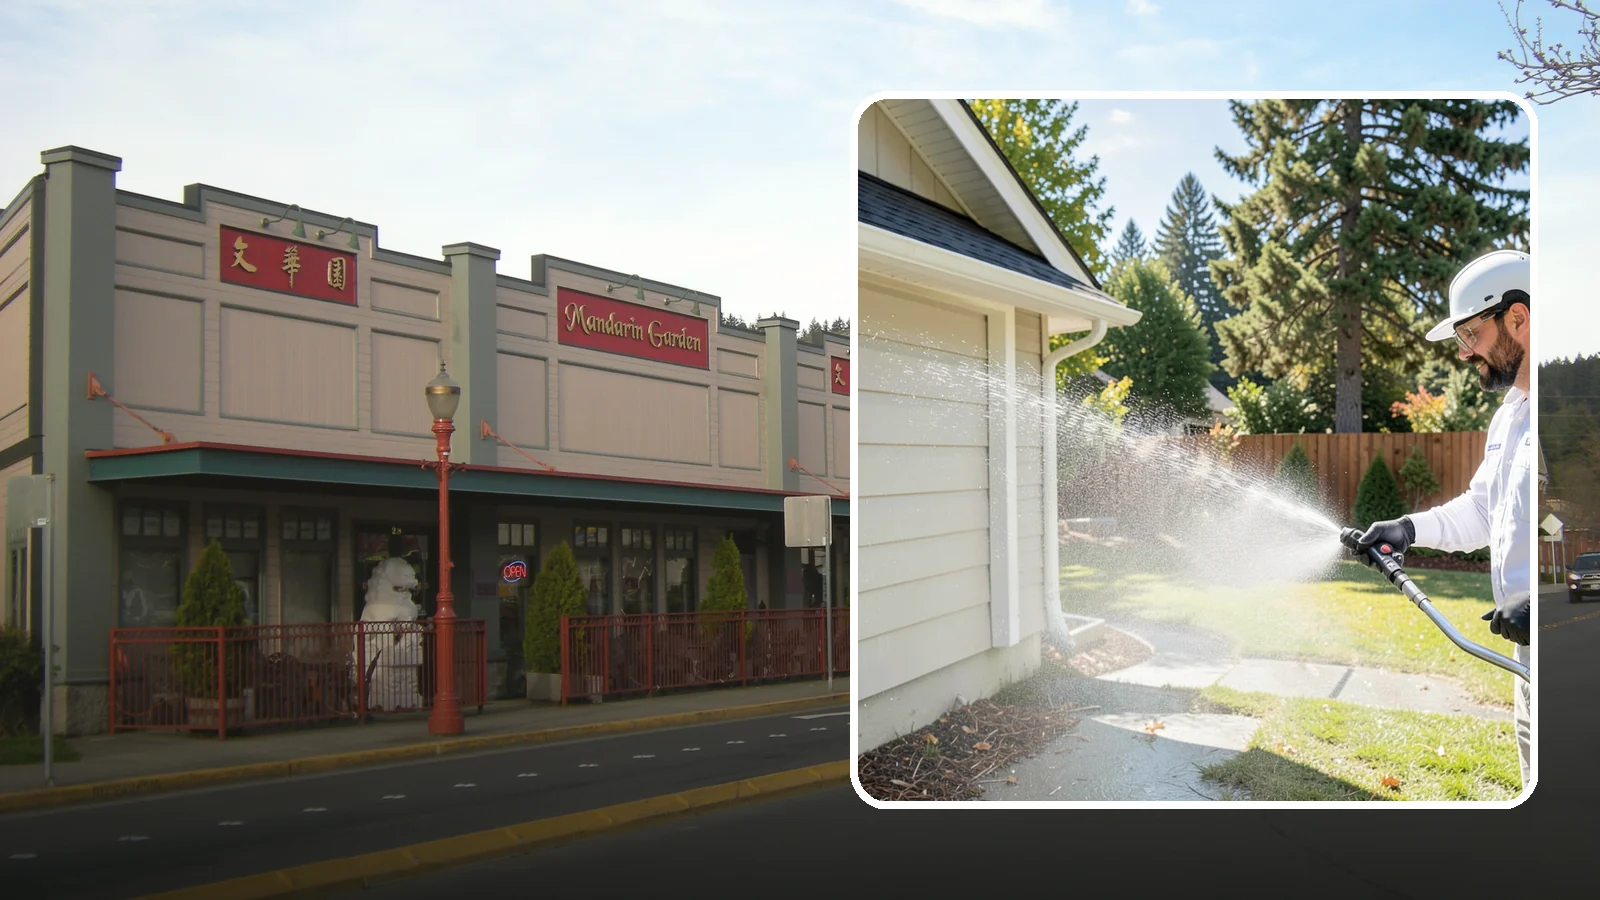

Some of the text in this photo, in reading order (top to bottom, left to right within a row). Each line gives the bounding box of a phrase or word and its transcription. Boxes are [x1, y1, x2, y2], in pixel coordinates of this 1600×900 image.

[231, 236, 346, 290] 文華園
[565, 302, 701, 352] Mandarin Garden
[835, 363, 846, 386] 文
[503, 565, 527, 578] OPEN
